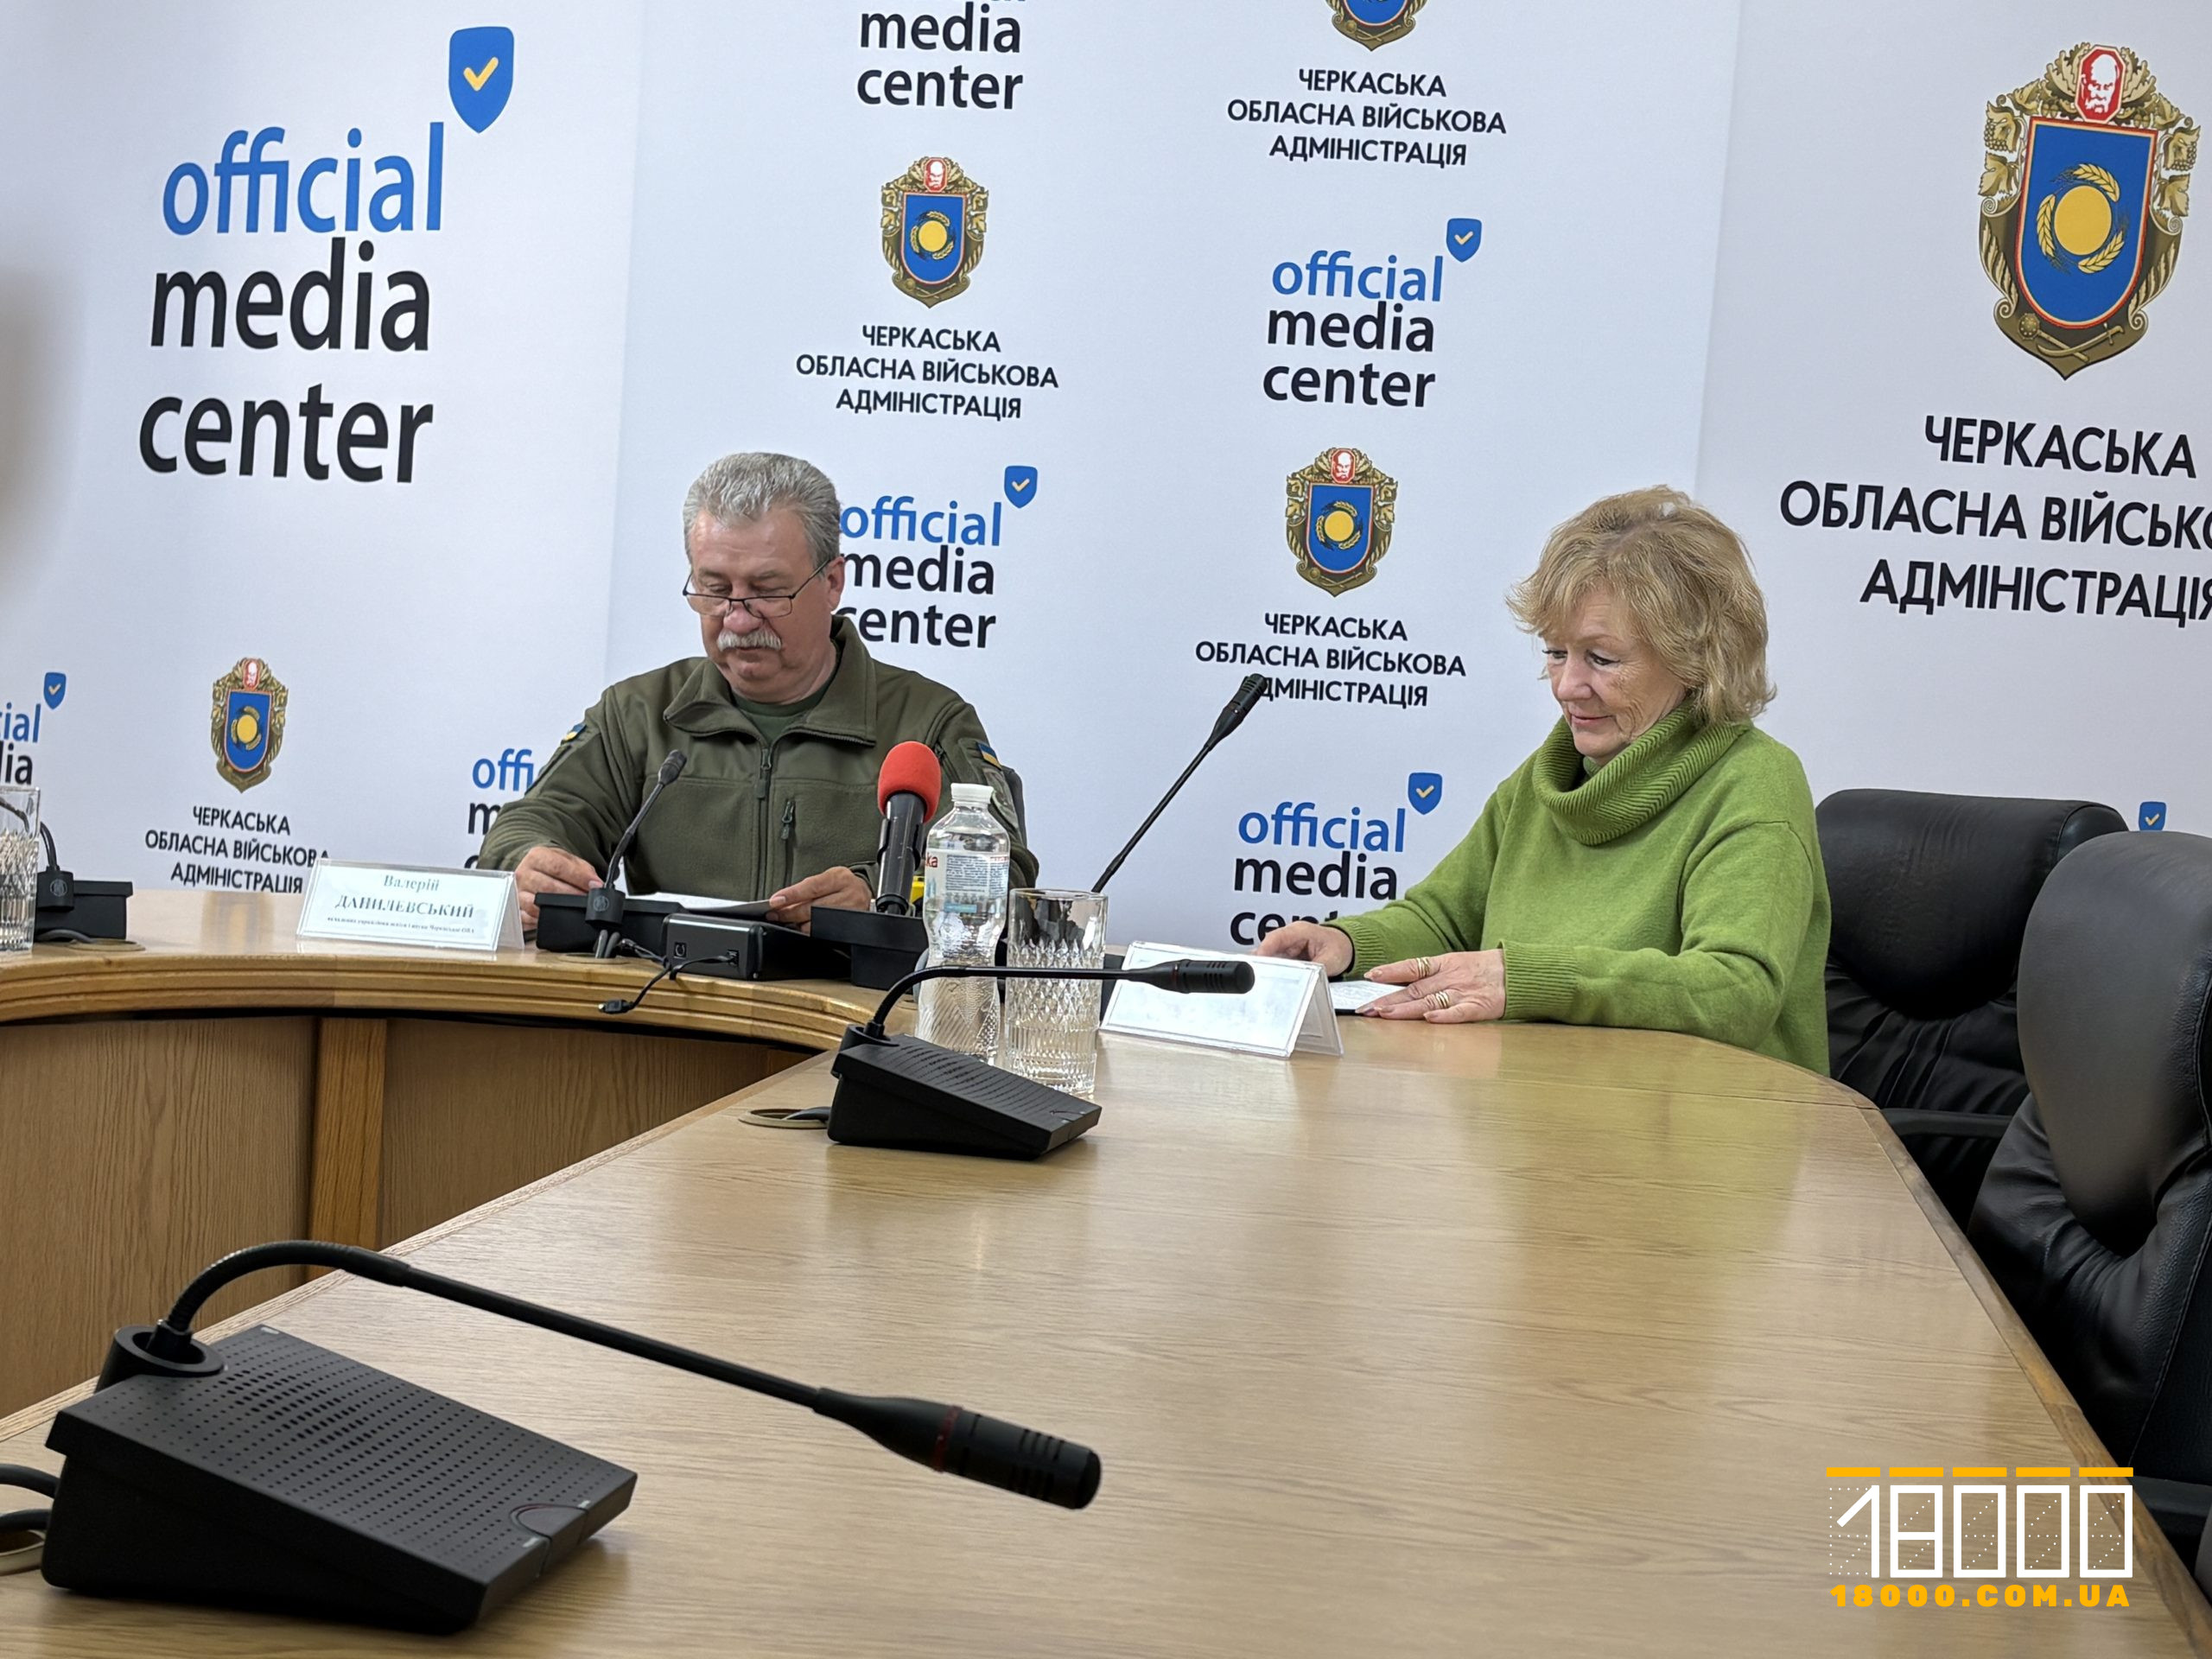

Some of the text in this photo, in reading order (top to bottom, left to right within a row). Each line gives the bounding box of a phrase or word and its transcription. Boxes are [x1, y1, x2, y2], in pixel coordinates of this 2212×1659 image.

[861, 2, 1020, 53] media
[857, 65, 1023, 110] center
[1299, 68, 1446, 98] ЧЕРКАСЬКА
[1227, 99, 1507, 134] ОБЛАСНА ВІЙСЬКОВА
[1269, 135, 1467, 168] АДМІНІСТРАЦІЯ
[162, 122, 444, 236] official
[150, 237, 430, 352] media
[1272, 250, 1443, 302] official
[862, 325, 1001, 353] ЧЕРКАСЬКА
[1268, 301, 1434, 353] media
[796, 353, 1059, 388] ОБЛАСНА ВІЙСЬКОВА
[1263, 363, 1436, 408] center
[836, 388, 1021, 422] АДМІНІСТРАЦІЯ
[139, 383, 434, 484] center
[1925, 415, 2197, 479] ЧЕРКАСЬКА
[841, 495, 1001, 547] official
[1780, 480, 2212, 550] ОБЛАСНА ВІЙСЬК
[841, 544, 995, 595] media
[1264, 613, 1408, 641] ЧЕРКАСЬКА
[1195, 641, 1467, 677] ОБЛАСНА ВІЙСЬКОВА
[1261, 677, 1428, 709] ДМІНІСТРАЦІЯ
[193, 805, 291, 836] ЧЕРКАСЬКА
[1238, 802, 1406, 853] official
[145, 830, 228, 859] ОБЛАСНА
[170, 861, 303, 894] АДМІНІСТРАЦІЯ
[384, 874, 441, 893] Валерій
[1234, 850, 1397, 900] media
